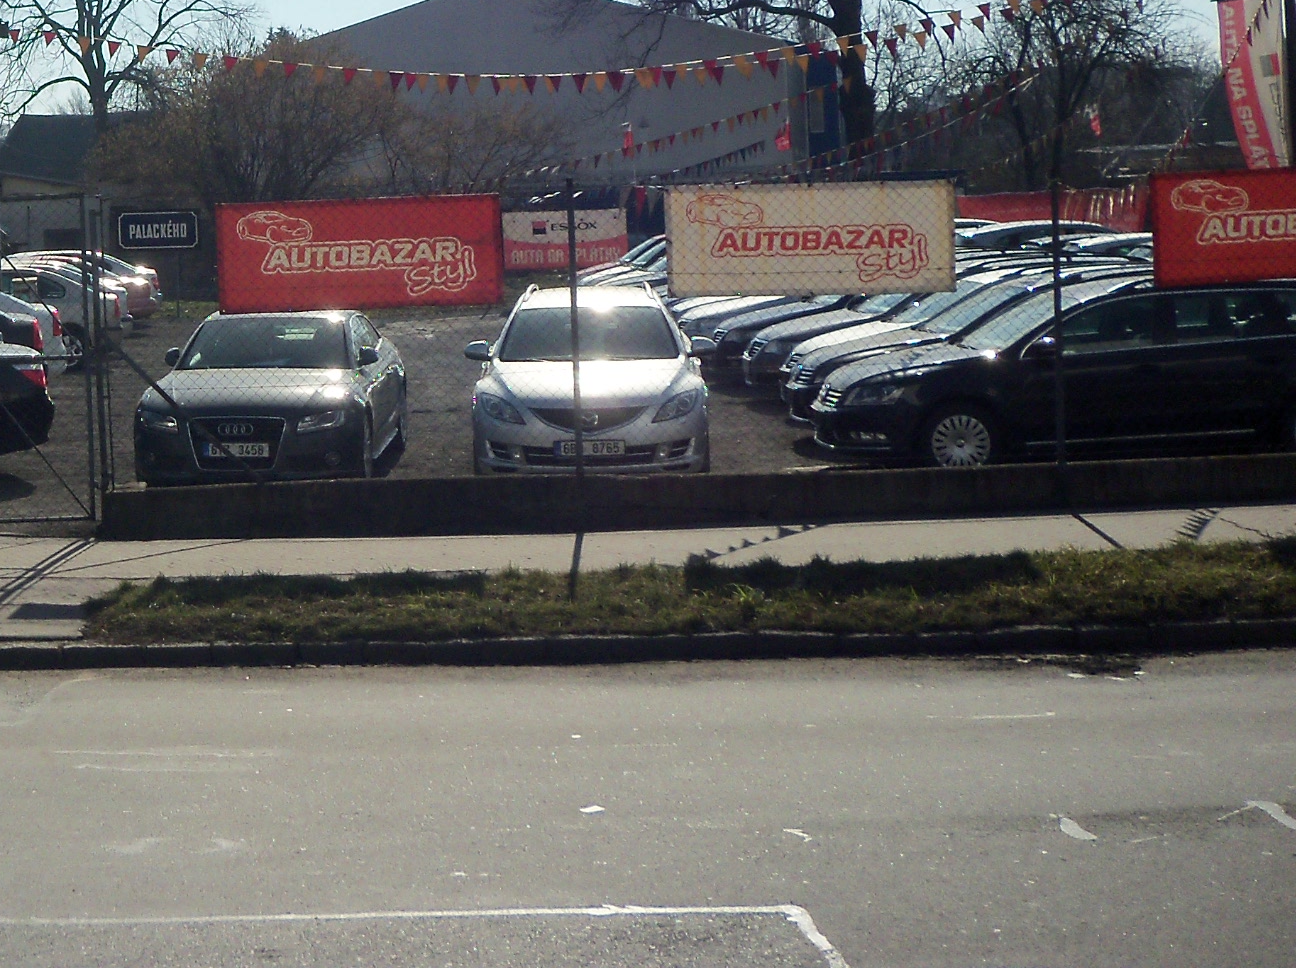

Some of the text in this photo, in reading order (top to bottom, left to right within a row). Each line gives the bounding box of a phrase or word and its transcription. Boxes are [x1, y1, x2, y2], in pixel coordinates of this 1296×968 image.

[1228, 67, 1248, 101] NA
[129, 219, 187, 240] PALACKÉHO
[550, 221, 598, 232] ESOX
[716, 228, 909, 253] AUTOBAZAR
[267, 240, 457, 269] AUTOBAZAR
[238, 444, 264, 456] 3458
[592, 441, 620, 454] 8765
